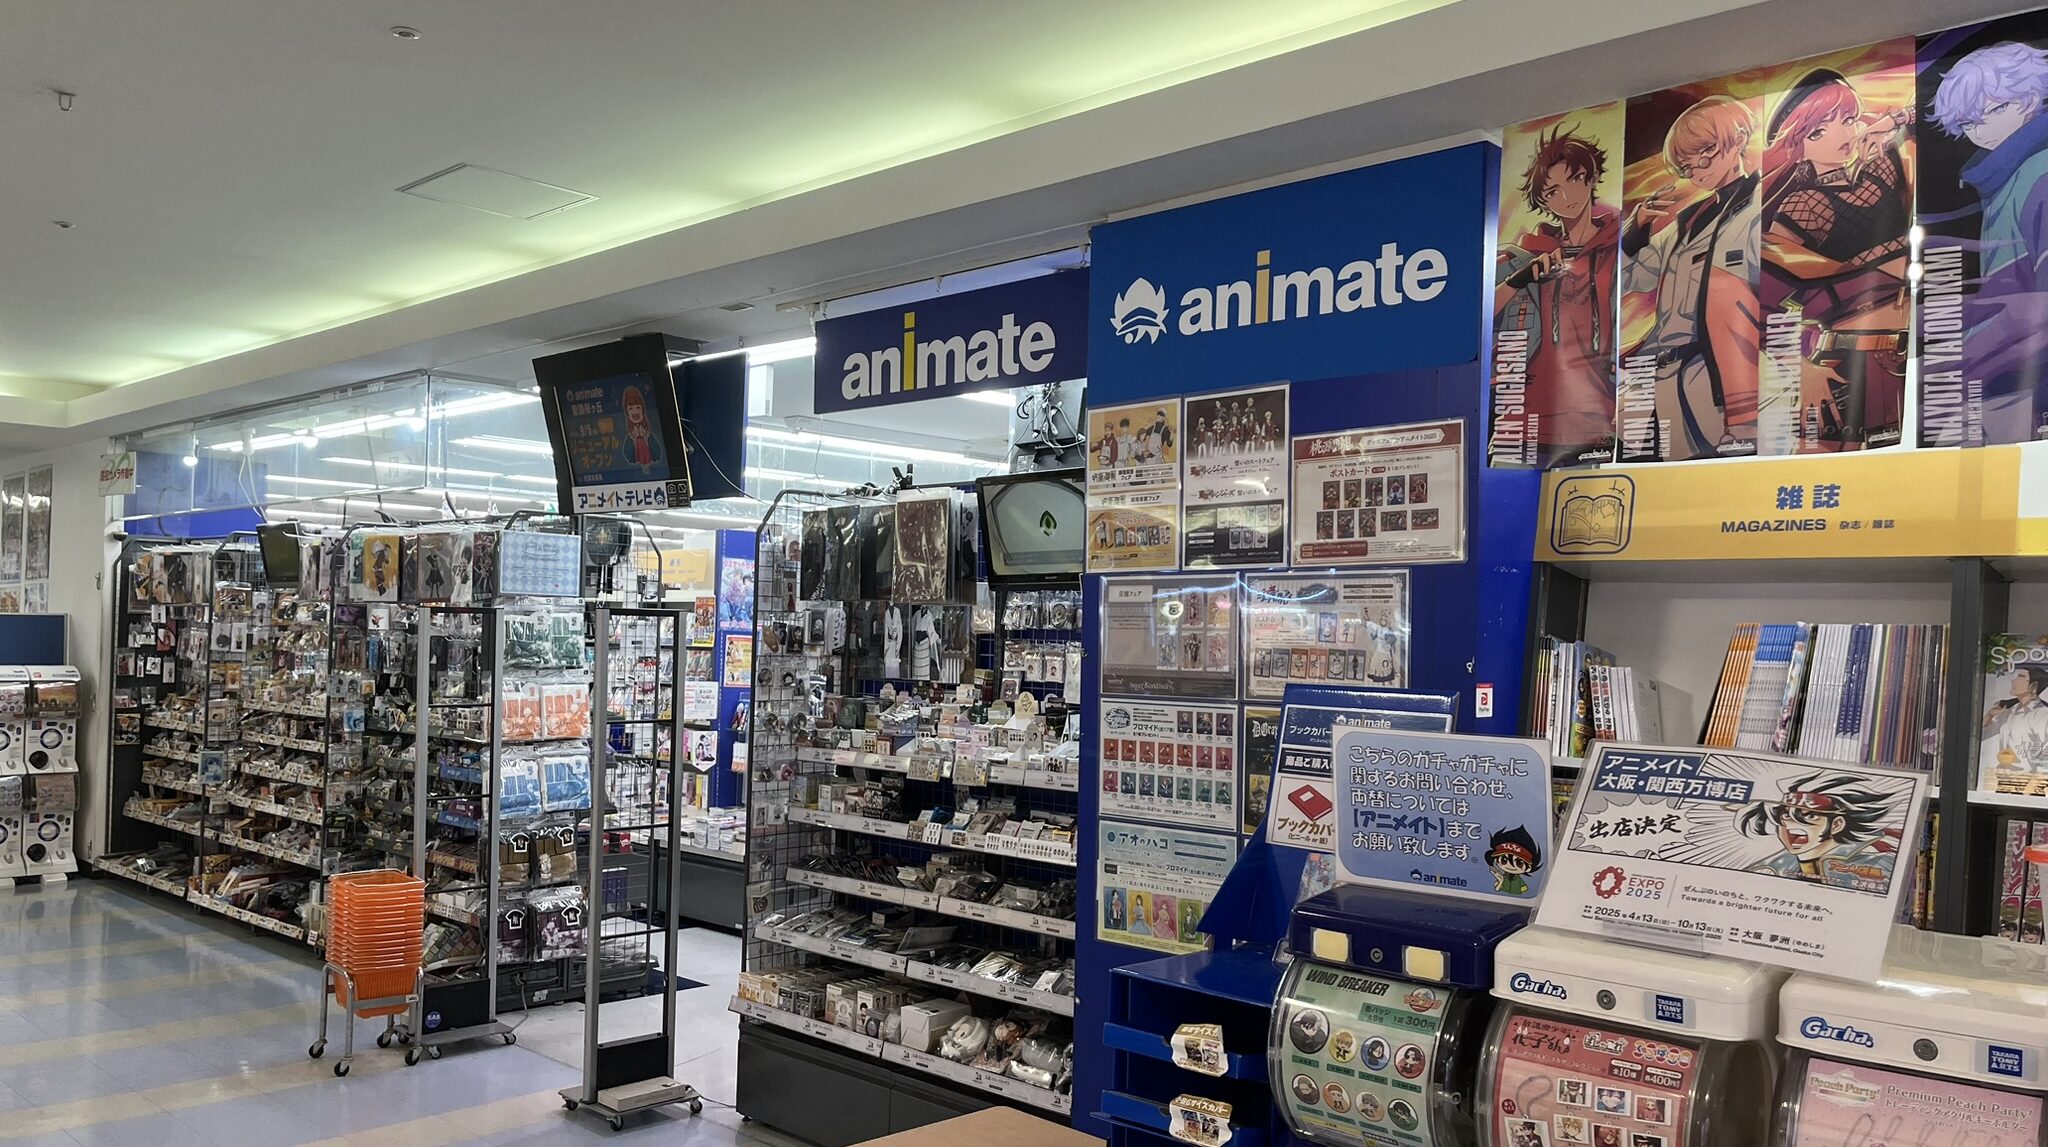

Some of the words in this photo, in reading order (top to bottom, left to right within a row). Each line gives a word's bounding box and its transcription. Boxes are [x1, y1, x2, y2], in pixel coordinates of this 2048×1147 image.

[1179, 243, 1448, 336] animate
[1924, 246, 1962, 367] YATONOKAMI
[842, 312, 1055, 400] animate
[1495, 330, 1528, 415] SUGASANO
[1624, 354, 1656, 412] HAJUN
[1924, 370, 1962, 442] NAYUTA
[1493, 421, 1524, 464] ALLEN
[1622, 417, 1654, 459] YEON
[1330, 467, 1370, 478] ポストカード
[578, 491, 652, 508] アニメイトテレビ
[1776, 484, 1841, 510] 雑誌
[1721, 518, 1827, 533] MAGAZINES
[1290, 726, 1333, 736] ブックカバー
[1347, 716, 1391, 729] animate
[1349, 745, 1528, 777] こちらのガチャガチャに
[1604, 754, 1692, 776] アニメイト
[1350, 767, 1514, 800] 関するお問い合わせ、
[1599, 774, 1749, 801] 大阪・関西万博店
[1351, 788, 1469, 816] 両替については
[1353, 808, 1482, 840] 【アニメイト】まで
[1589, 814, 1681, 839] 出店決定
[1119, 832, 1168, 849] アオのハコ
[1352, 832, 1479, 863] お願い致します。
[1423, 869, 1467, 887] animate
[1629, 877, 1664, 890] EXPO
[1626, 887, 1661, 900] 2025
[1681, 894, 1716, 905] Towards
[1726, 901, 1762, 912] brighter
[1764, 907, 1792, 917] future
[1742, 930, 1763, 941] 大阪
[1306, 969, 1338, 985] WIND
[1337, 975, 1390, 996] BREAKER
[1657, 997, 1682, 1007] TAKARA
[1658, 1004, 1682, 1013] TOMY
[1405, 1016, 1436, 1030] 300円
[1992, 1050, 2020, 1060] TAKARA
[1992, 1057, 2019, 1066] TOMY
[1811, 1076, 1843, 1091] Peach
[1845, 1083, 1880, 1100] Party!
[1888, 1085, 1942, 1103] Premium
[1948, 1096, 1986, 1111] Peach
[1992, 1103, 2033, 1119] Party!
